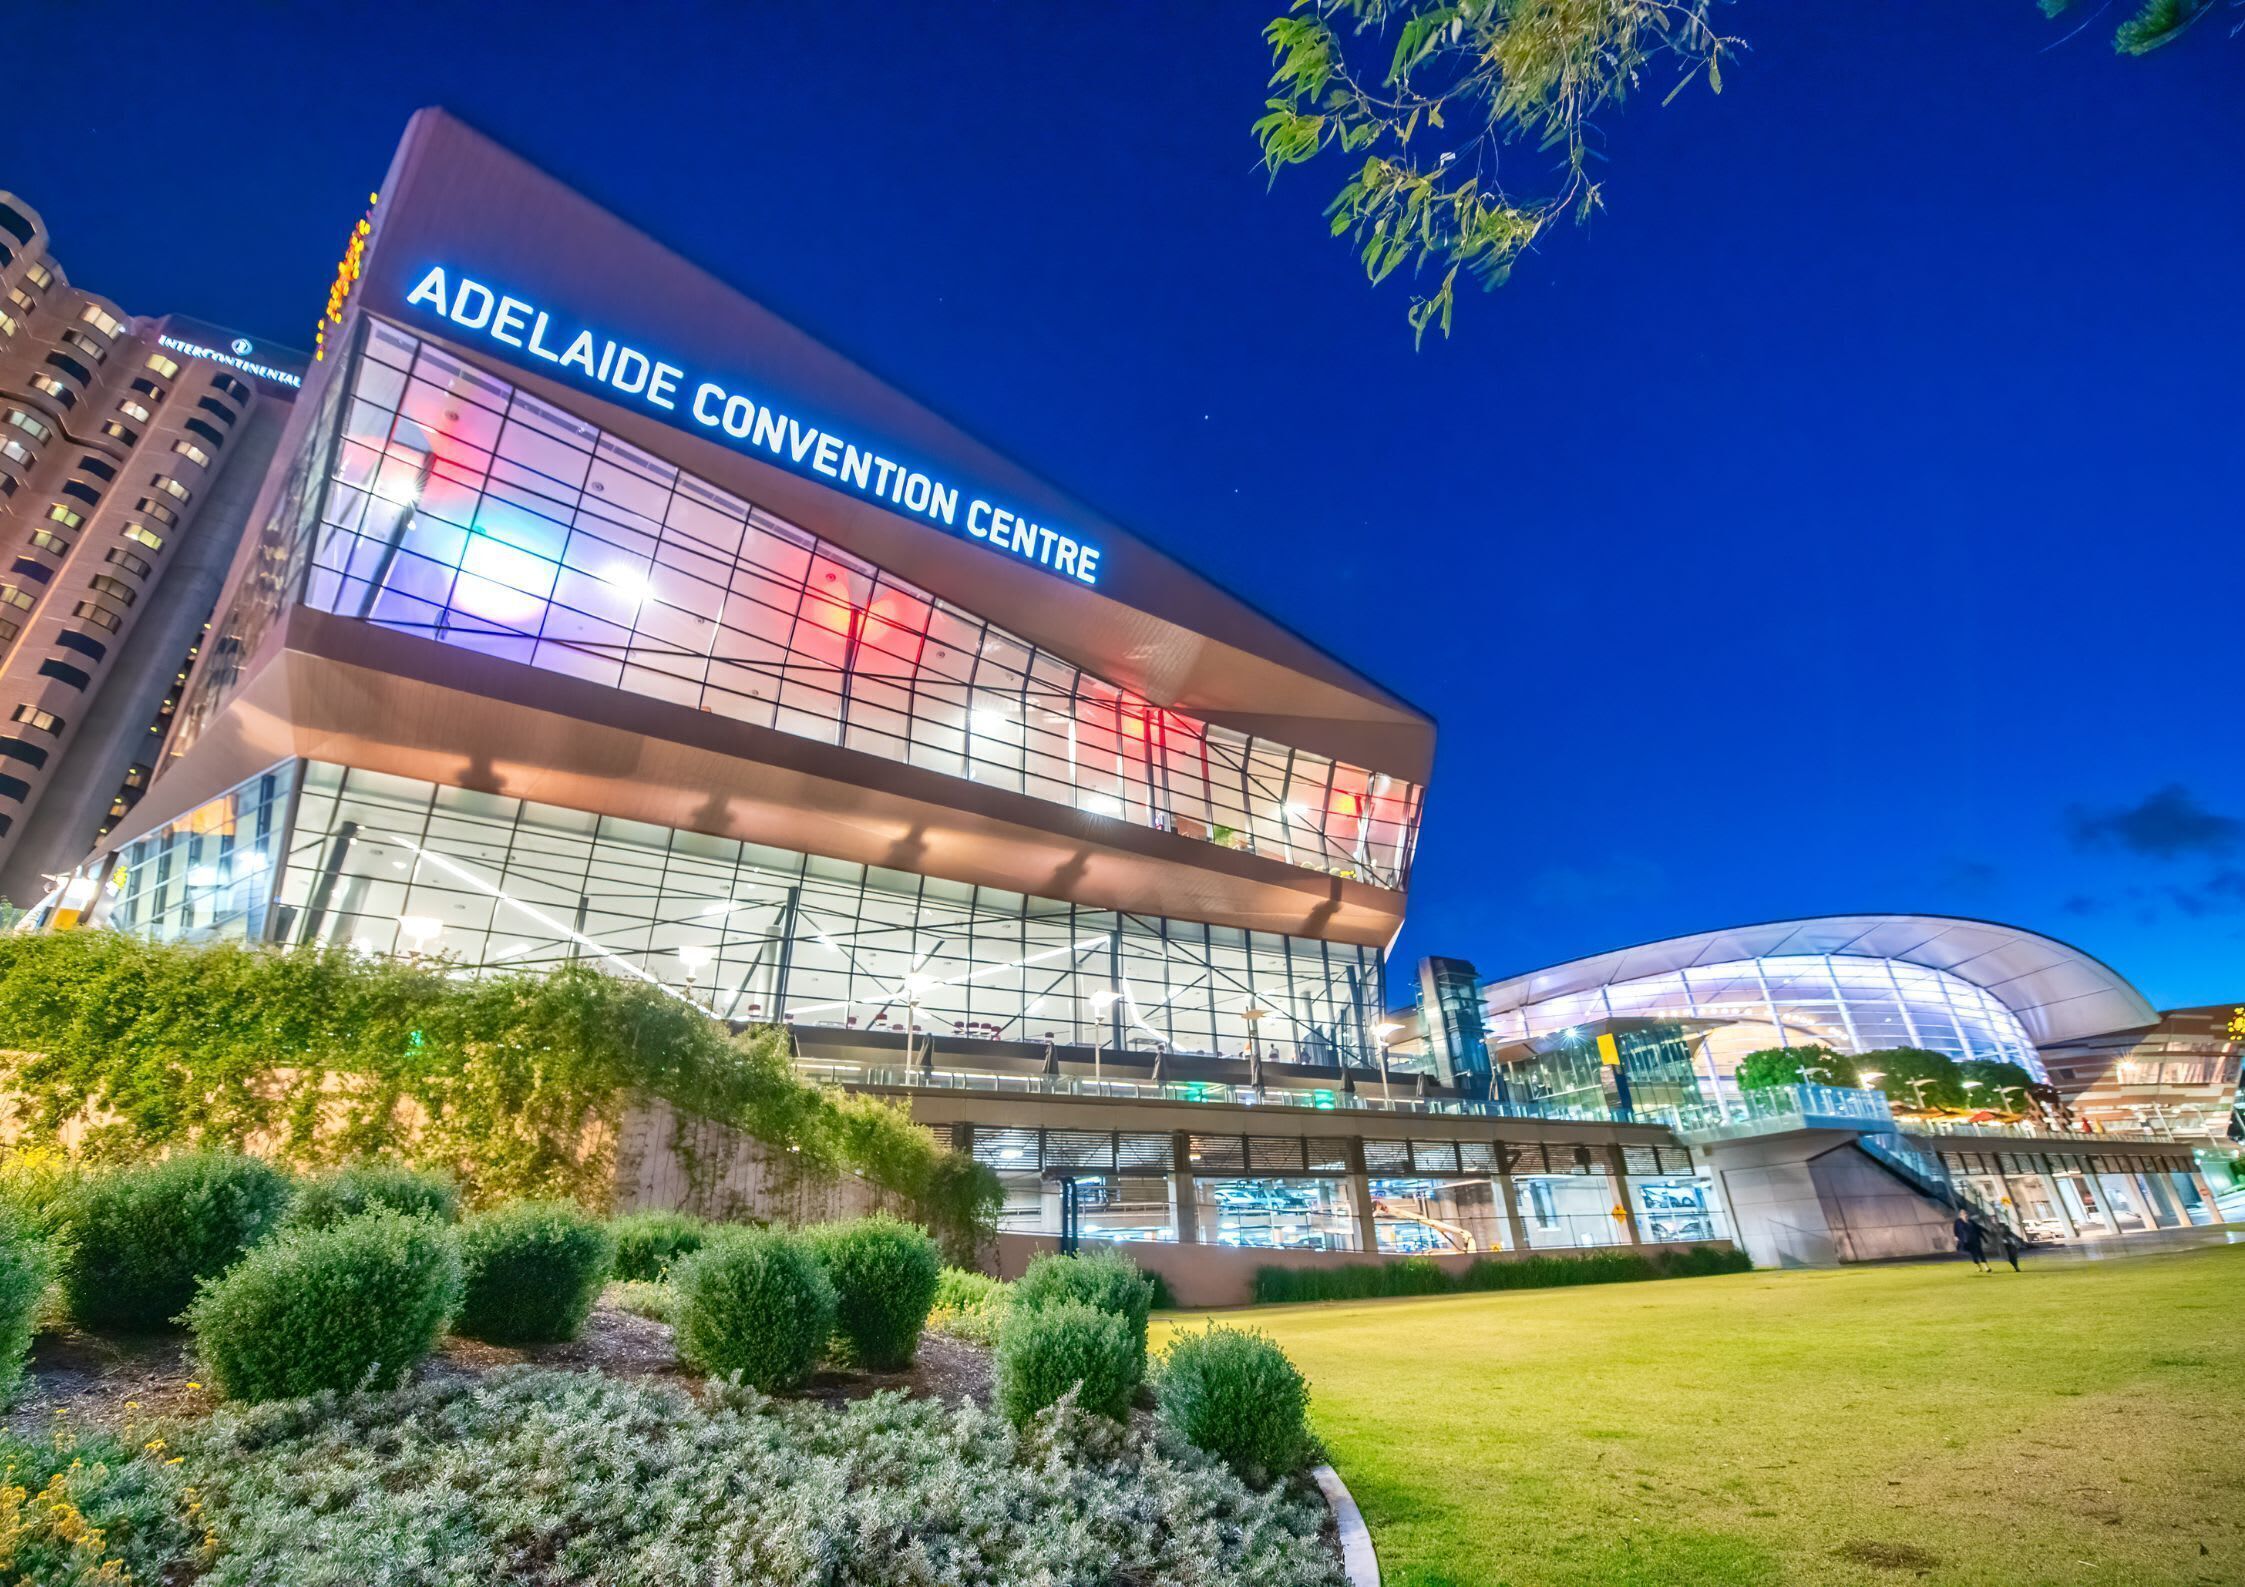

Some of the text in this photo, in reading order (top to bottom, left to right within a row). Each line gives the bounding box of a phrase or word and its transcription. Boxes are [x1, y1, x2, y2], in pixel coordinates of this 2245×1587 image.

[406, 266, 1101, 584] ADELAIDE CONVENTION CENTRE
